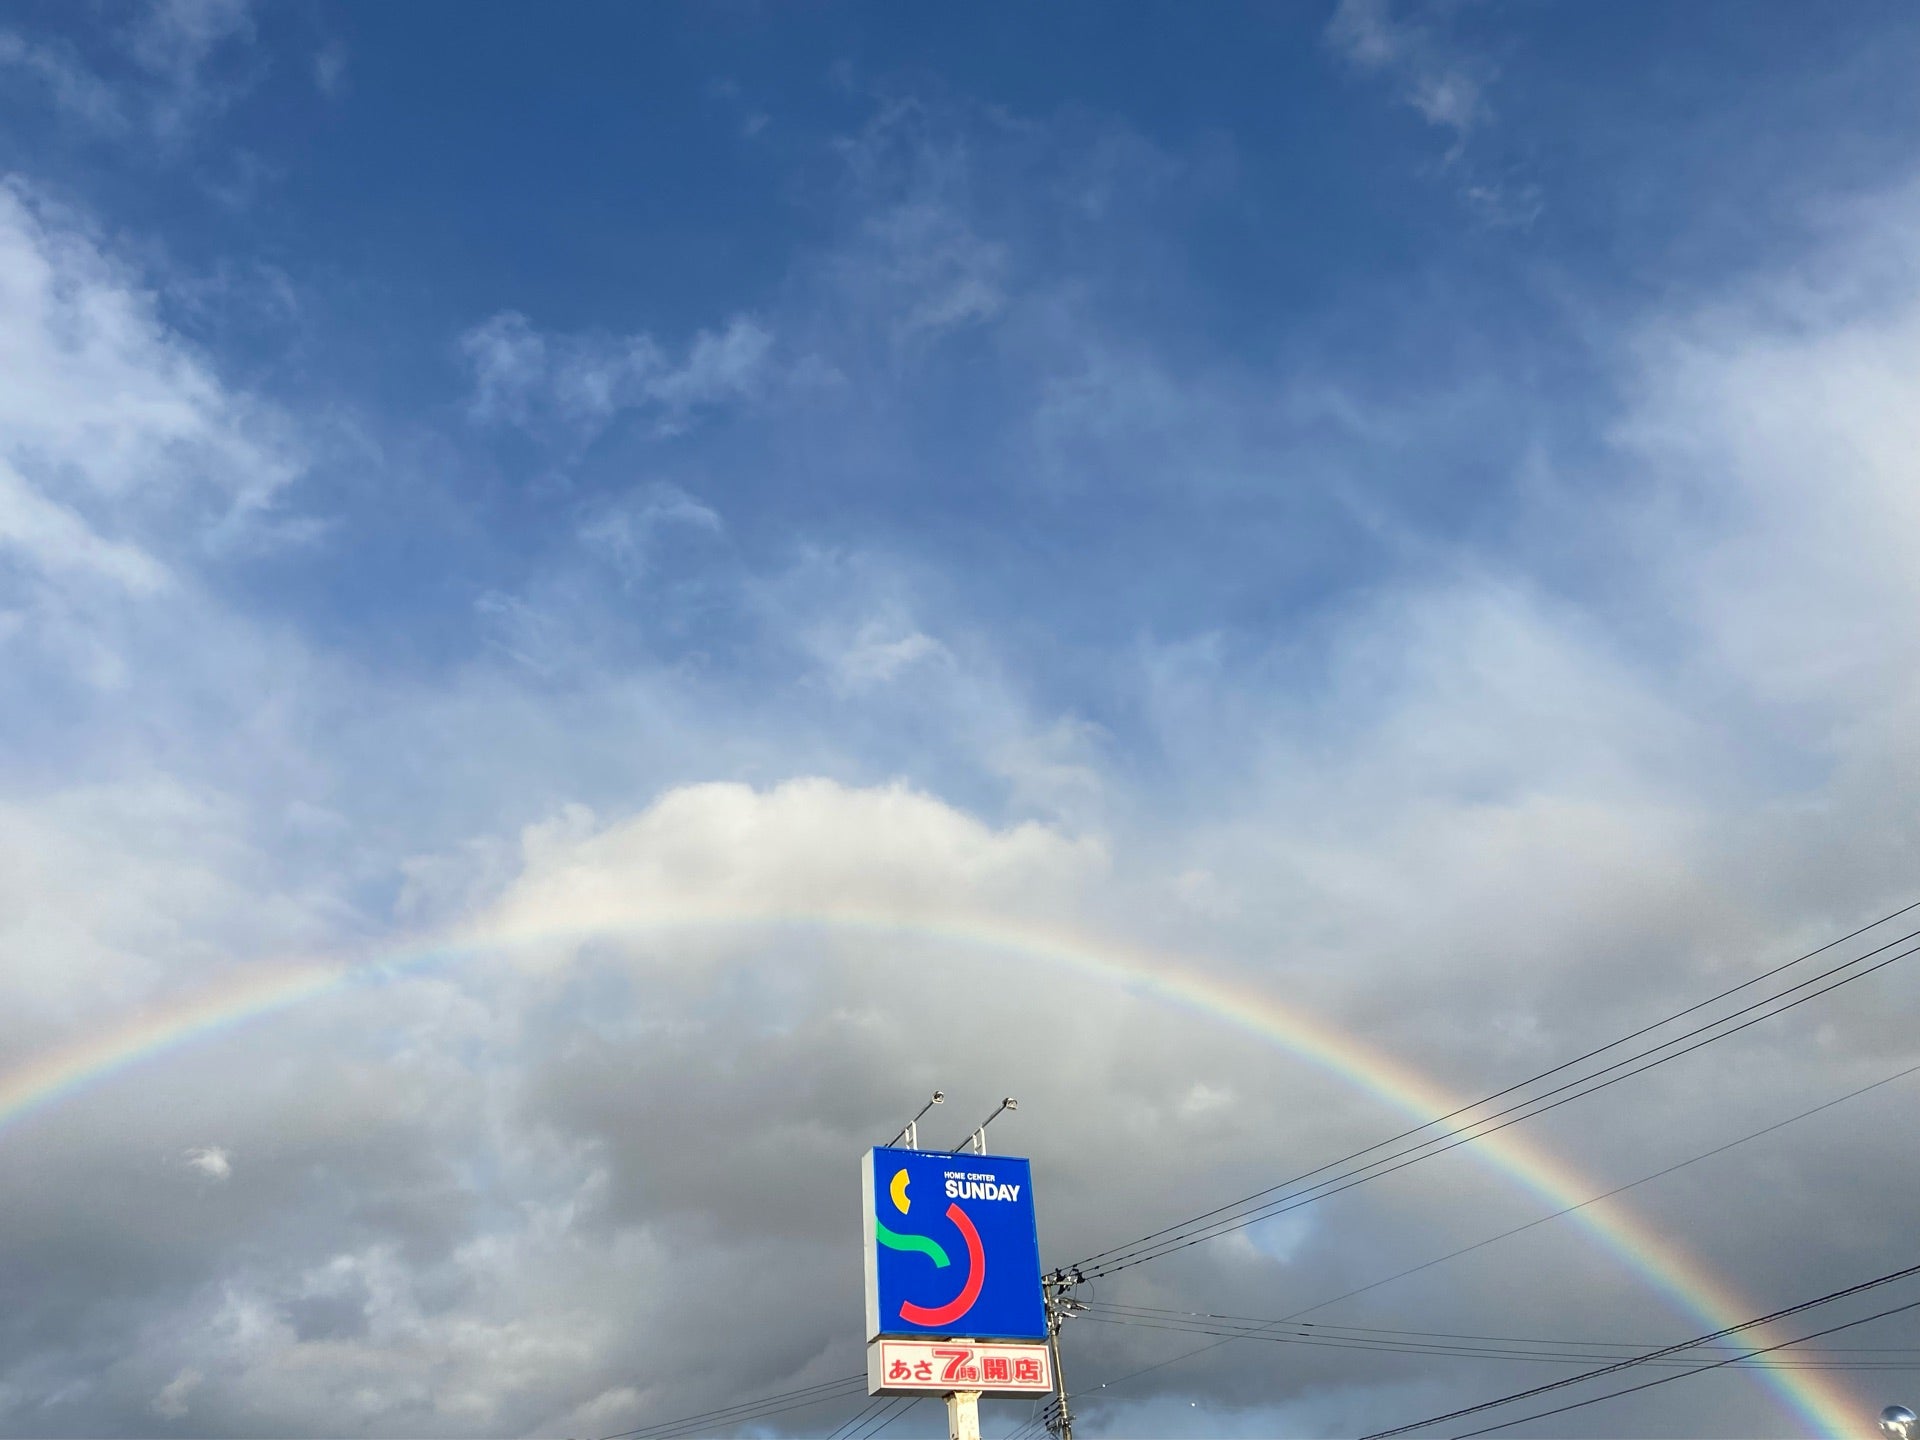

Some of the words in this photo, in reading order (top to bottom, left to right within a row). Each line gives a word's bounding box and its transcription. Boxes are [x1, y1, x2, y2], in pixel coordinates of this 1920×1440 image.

[944, 1171, 965, 1180] HOME
[967, 1173, 995, 1182] CENTER
[945, 1180, 1020, 1202] SUNDAY
